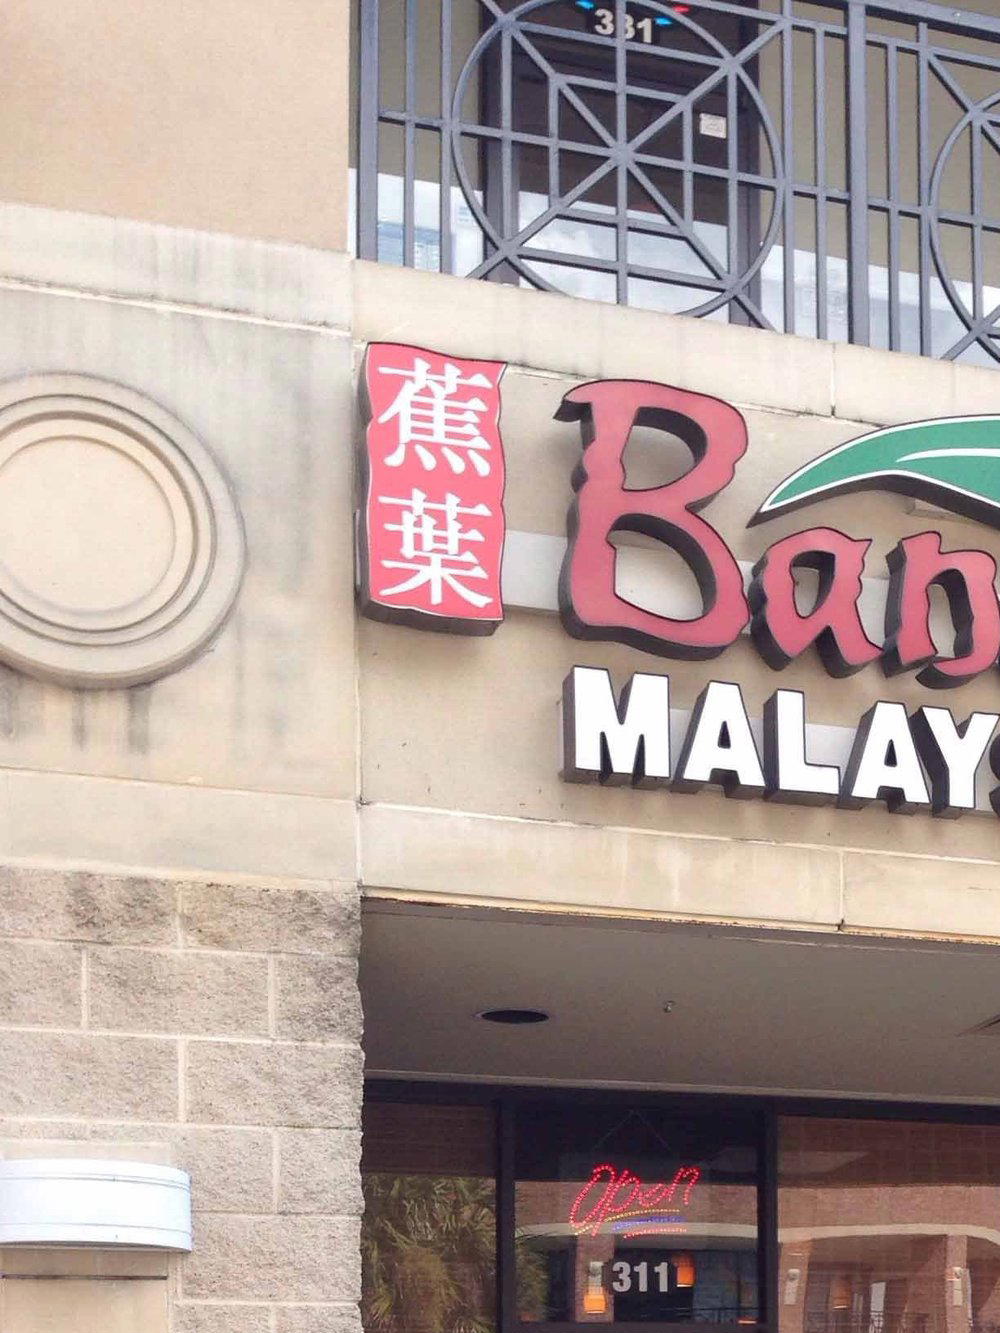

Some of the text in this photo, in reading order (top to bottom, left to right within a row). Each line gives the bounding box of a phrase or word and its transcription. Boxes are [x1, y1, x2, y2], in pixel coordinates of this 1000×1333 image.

[594, 8, 652, 44] 331
[377, 356, 496, 609] 蕉葉
[612, 1261, 668, 1292] 311
